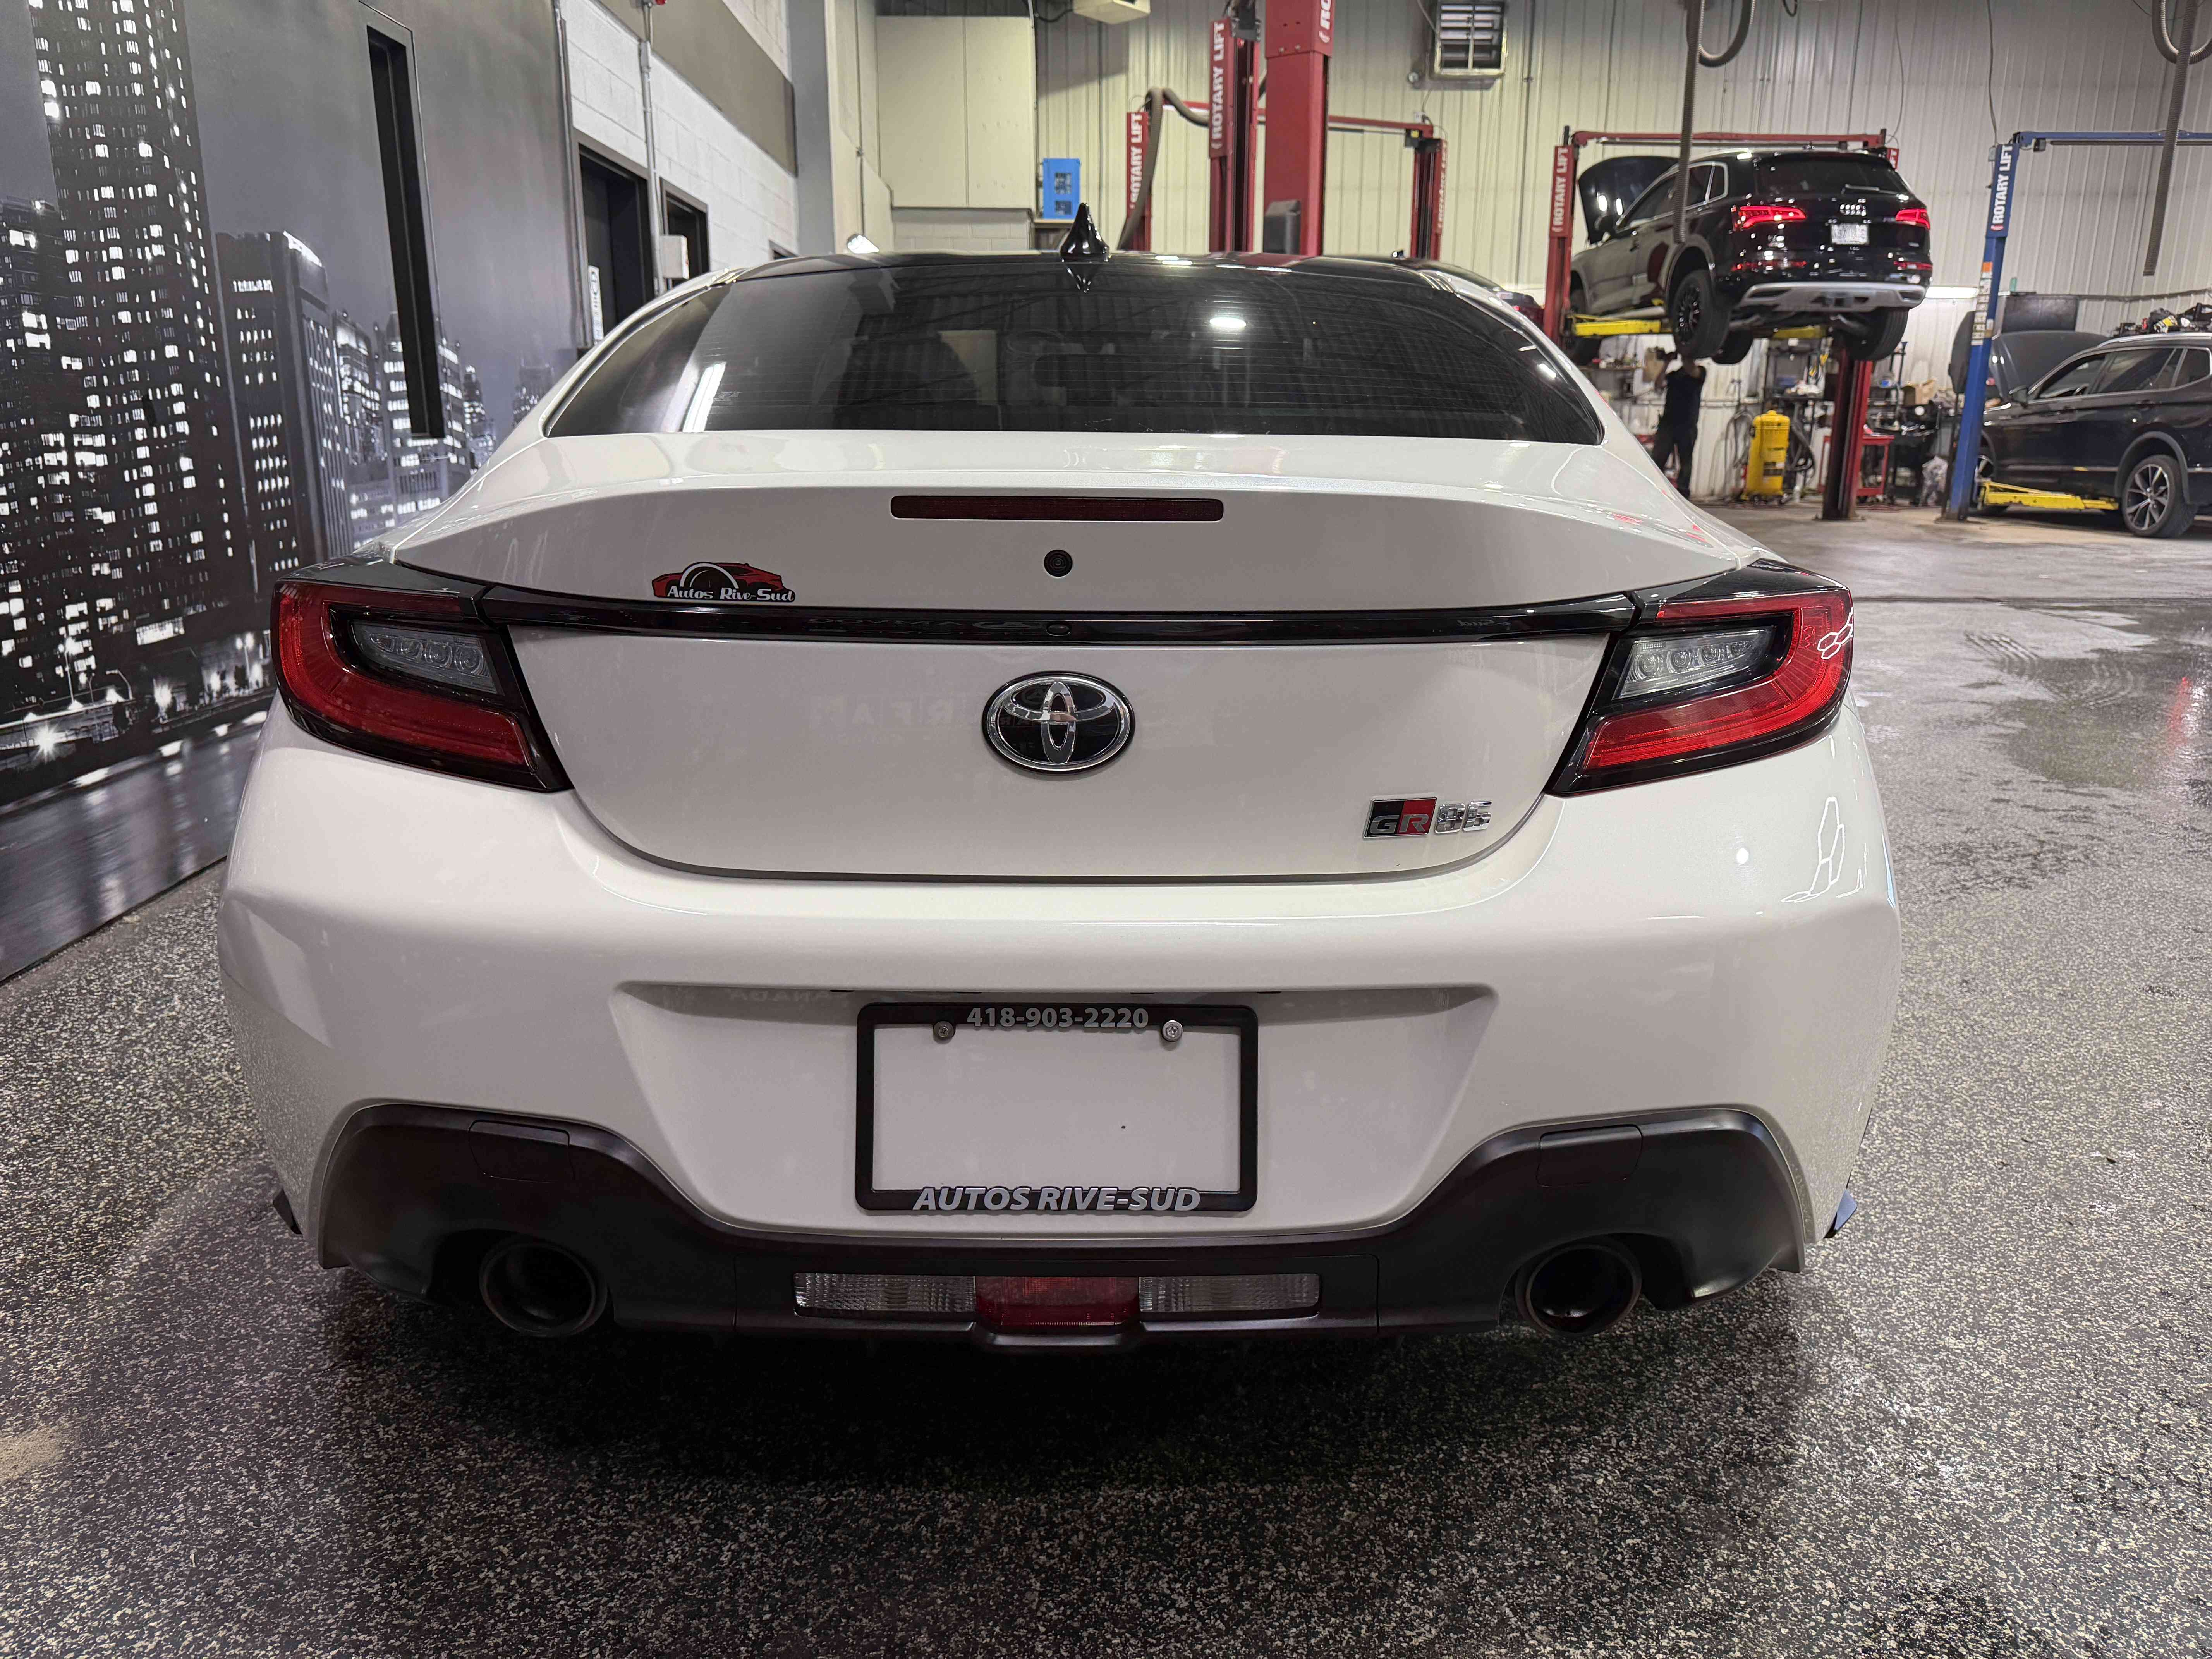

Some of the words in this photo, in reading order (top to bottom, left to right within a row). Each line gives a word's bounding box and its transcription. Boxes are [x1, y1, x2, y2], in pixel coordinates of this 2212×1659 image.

[1214, 22, 1224, 61] LIFT
[1212, 66, 1224, 139] ROTARY
[1131, 113, 1142, 143] LIFT
[1556, 148, 1568, 173] LIFT
[1999, 145, 2013, 171] LIFT
[1553, 176, 1566, 226] ROTARY
[1992, 174, 2009, 224] ROTARY
[667, 586, 713, 599] Autos
[720, 587, 794, 601] Rive-Sud
[1370, 814, 1429, 834] GR
[1435, 801, 1493, 834] 86
[967, 1007, 1149, 1028] 418-903-2220
[912, 1187, 1031, 1211] AUTOS
[1037, 1187, 1201, 1211] RIVE-SUD
